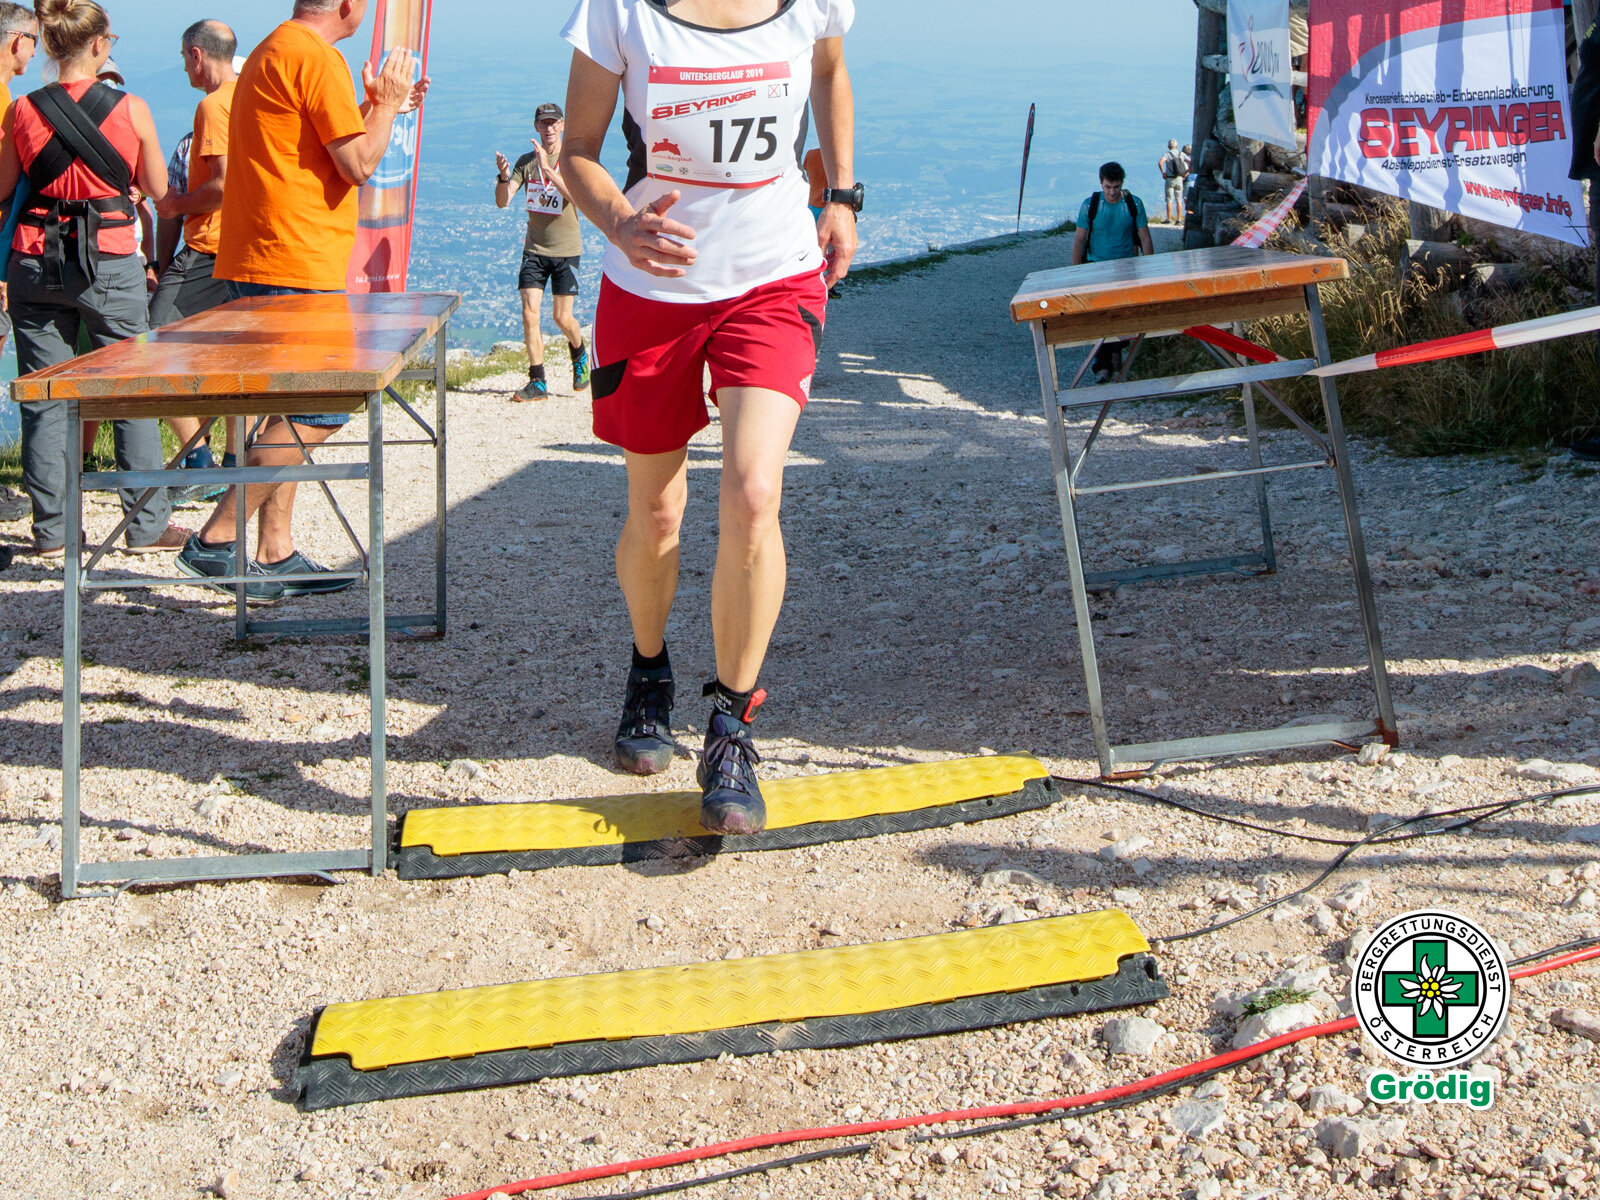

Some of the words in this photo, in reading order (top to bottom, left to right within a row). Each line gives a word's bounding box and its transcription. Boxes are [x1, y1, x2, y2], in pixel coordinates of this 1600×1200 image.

[679, 69, 744, 81] UNTERSBERGLAUF
[745, 67, 764, 78] 2019
[651, 89, 757, 120] SEYRINGER
[710, 116, 777, 163] 175
[1358, 101, 1566, 158] SEYRINGER
